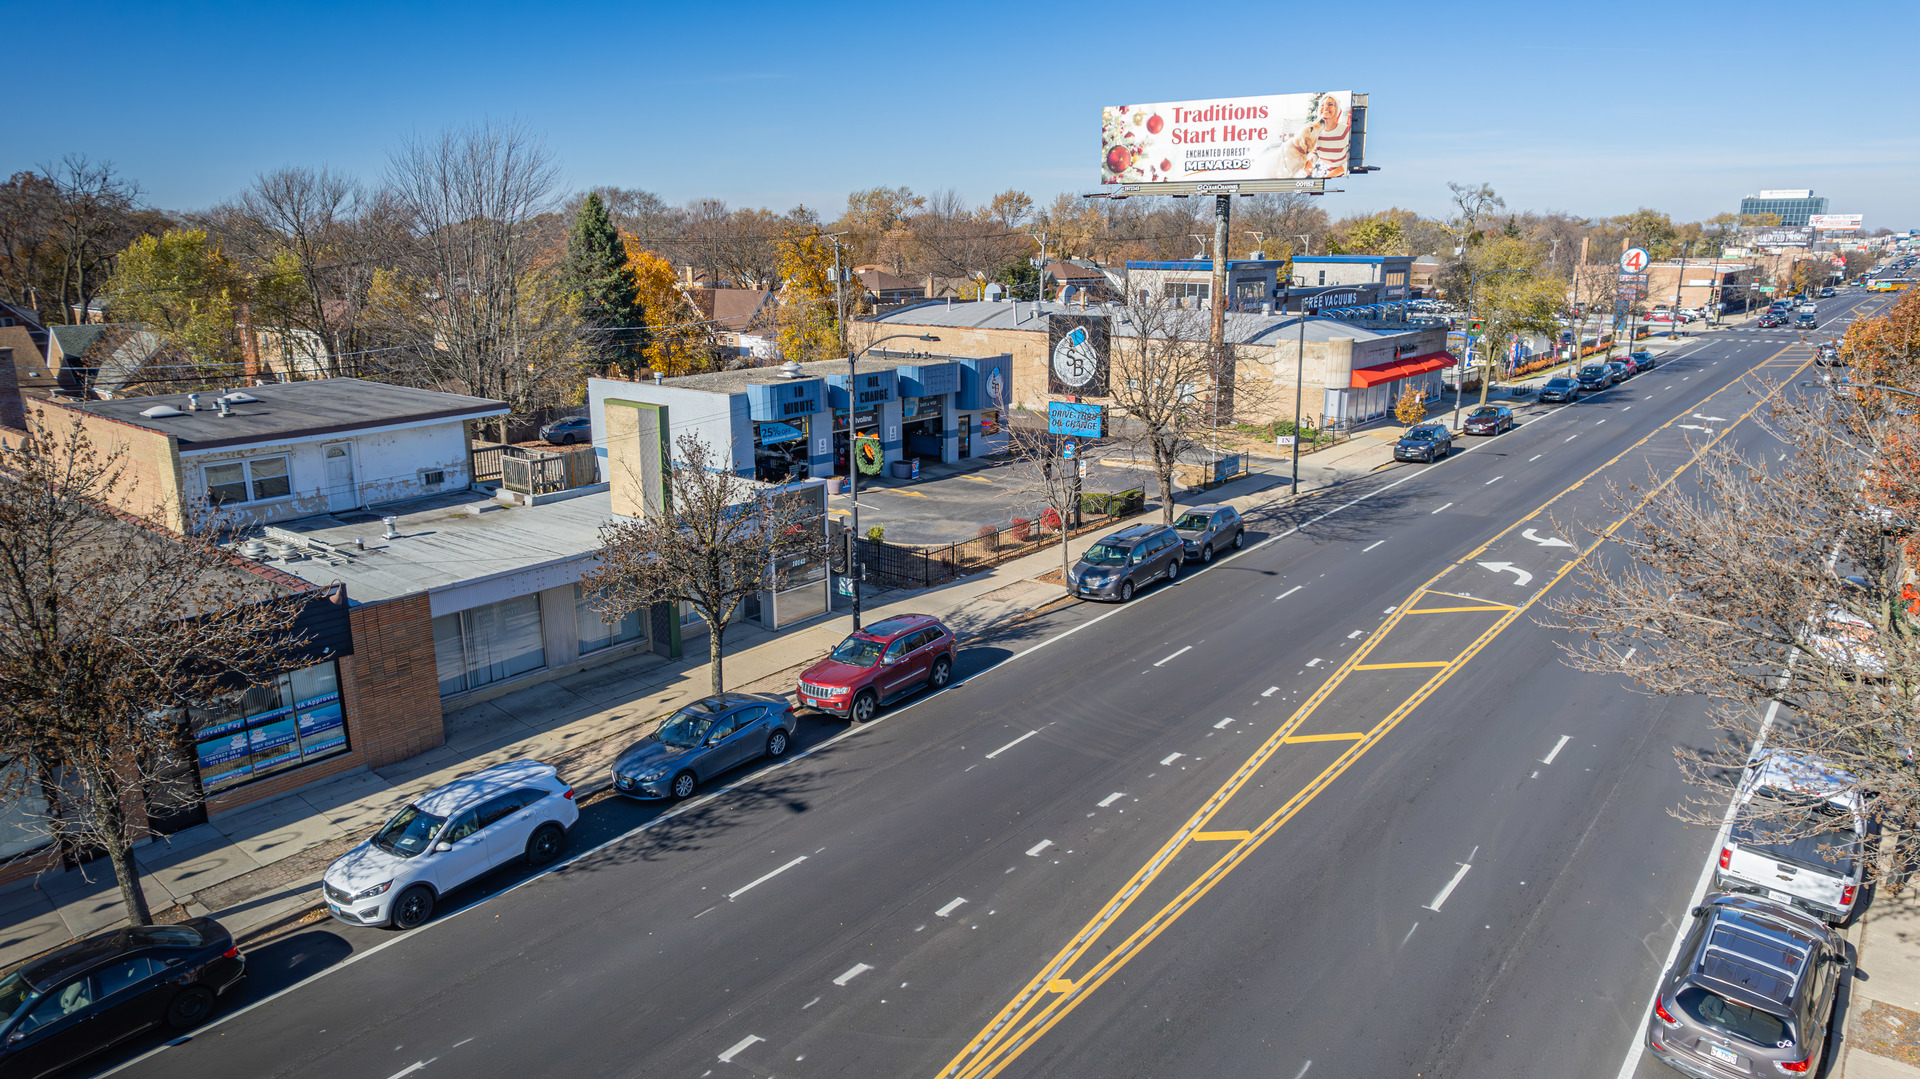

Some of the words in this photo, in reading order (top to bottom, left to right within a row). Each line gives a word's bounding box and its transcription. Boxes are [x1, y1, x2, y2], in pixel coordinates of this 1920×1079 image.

[1172, 104, 1269, 123] Traditions
[1171, 127, 1216, 145] Start
[1223, 125, 1268, 142] Here
[1186, 149, 1221, 158] ENCHANTED
[1223, 147, 1245, 156] FOREST
[1185, 159, 1251, 171] MENARDS
[1304, 295, 1323, 309] FREE
[1325, 292, 1357, 307] VACUUMS
[868, 376, 880, 388] OIL
[794, 386, 804, 398] 10
[860, 389, 889, 404] CHANGE
[784, 400, 815, 415] MINUTE
[1065, 420, 1098, 430] CHANGE
[761, 426, 780, 438] 25%
[307, 693, 338, 706] Approved
[198, 726, 225, 738] Private
[227, 722, 241, 730] Pay
[316, 739, 345, 750] Prevention
[205, 751, 228, 762] CONTACT
